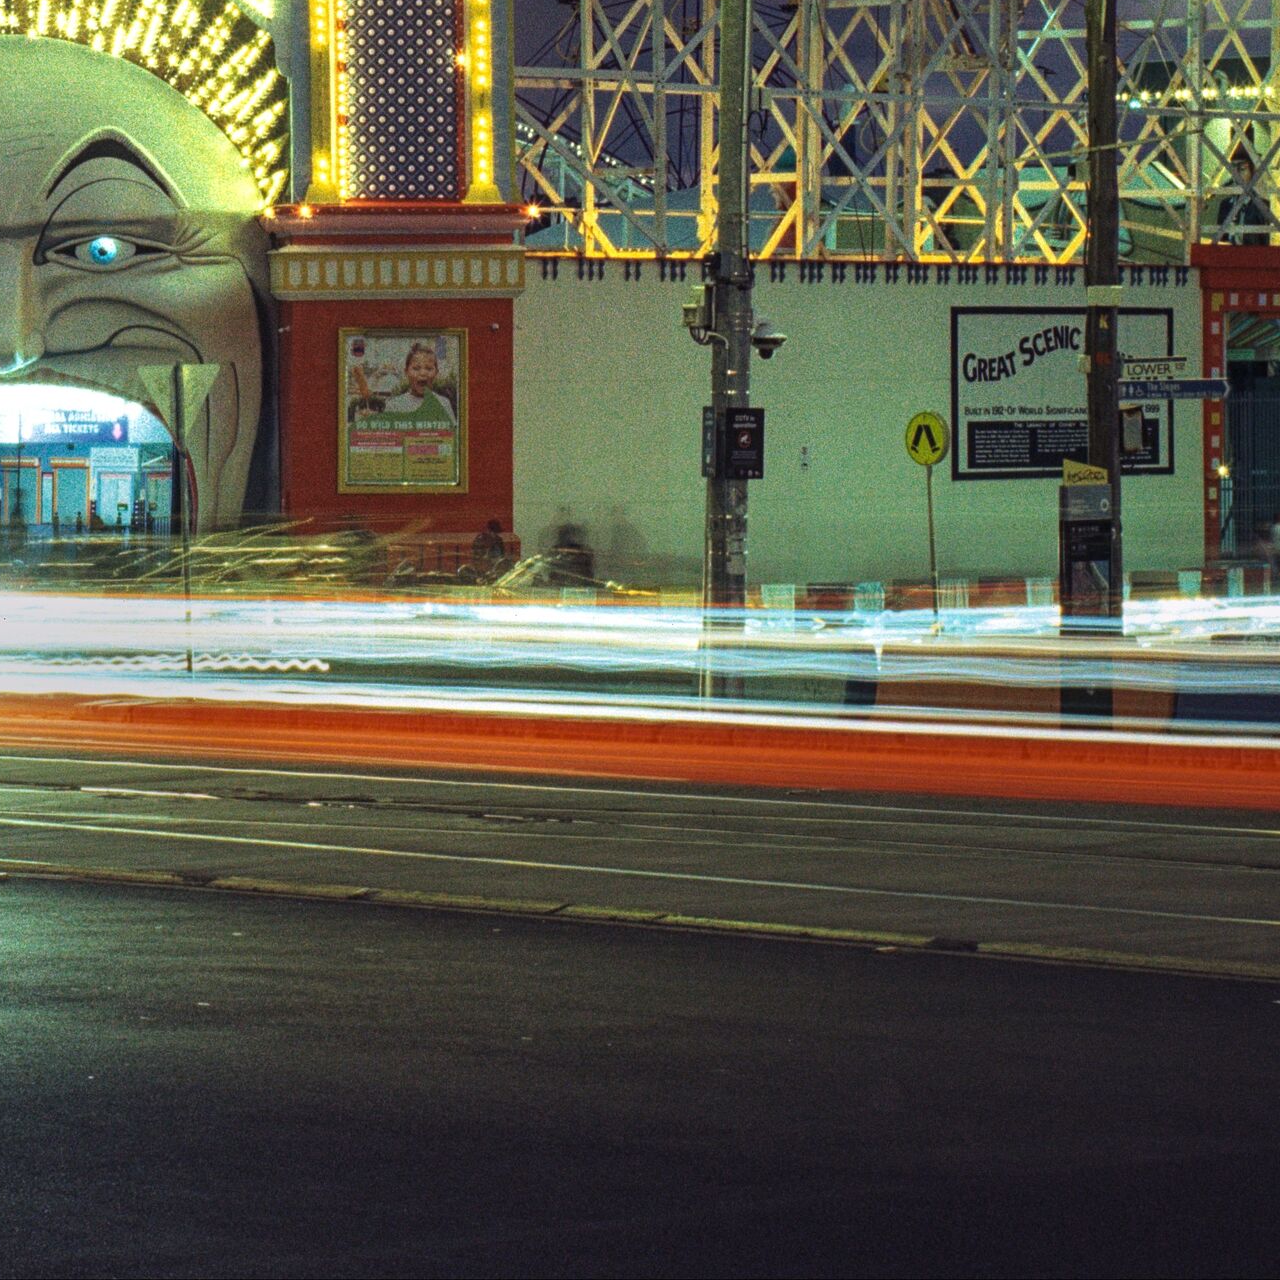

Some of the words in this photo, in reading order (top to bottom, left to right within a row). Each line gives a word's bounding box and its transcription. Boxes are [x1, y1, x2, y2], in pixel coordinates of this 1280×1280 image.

[962, 351, 1017, 383] GREAT
[1018, 325, 1082, 367] SCENIC
[1126, 363, 1172, 377] LOWER
[964, 405, 982, 416] BUILT
[1018, 405, 1043, 415] WORLD
